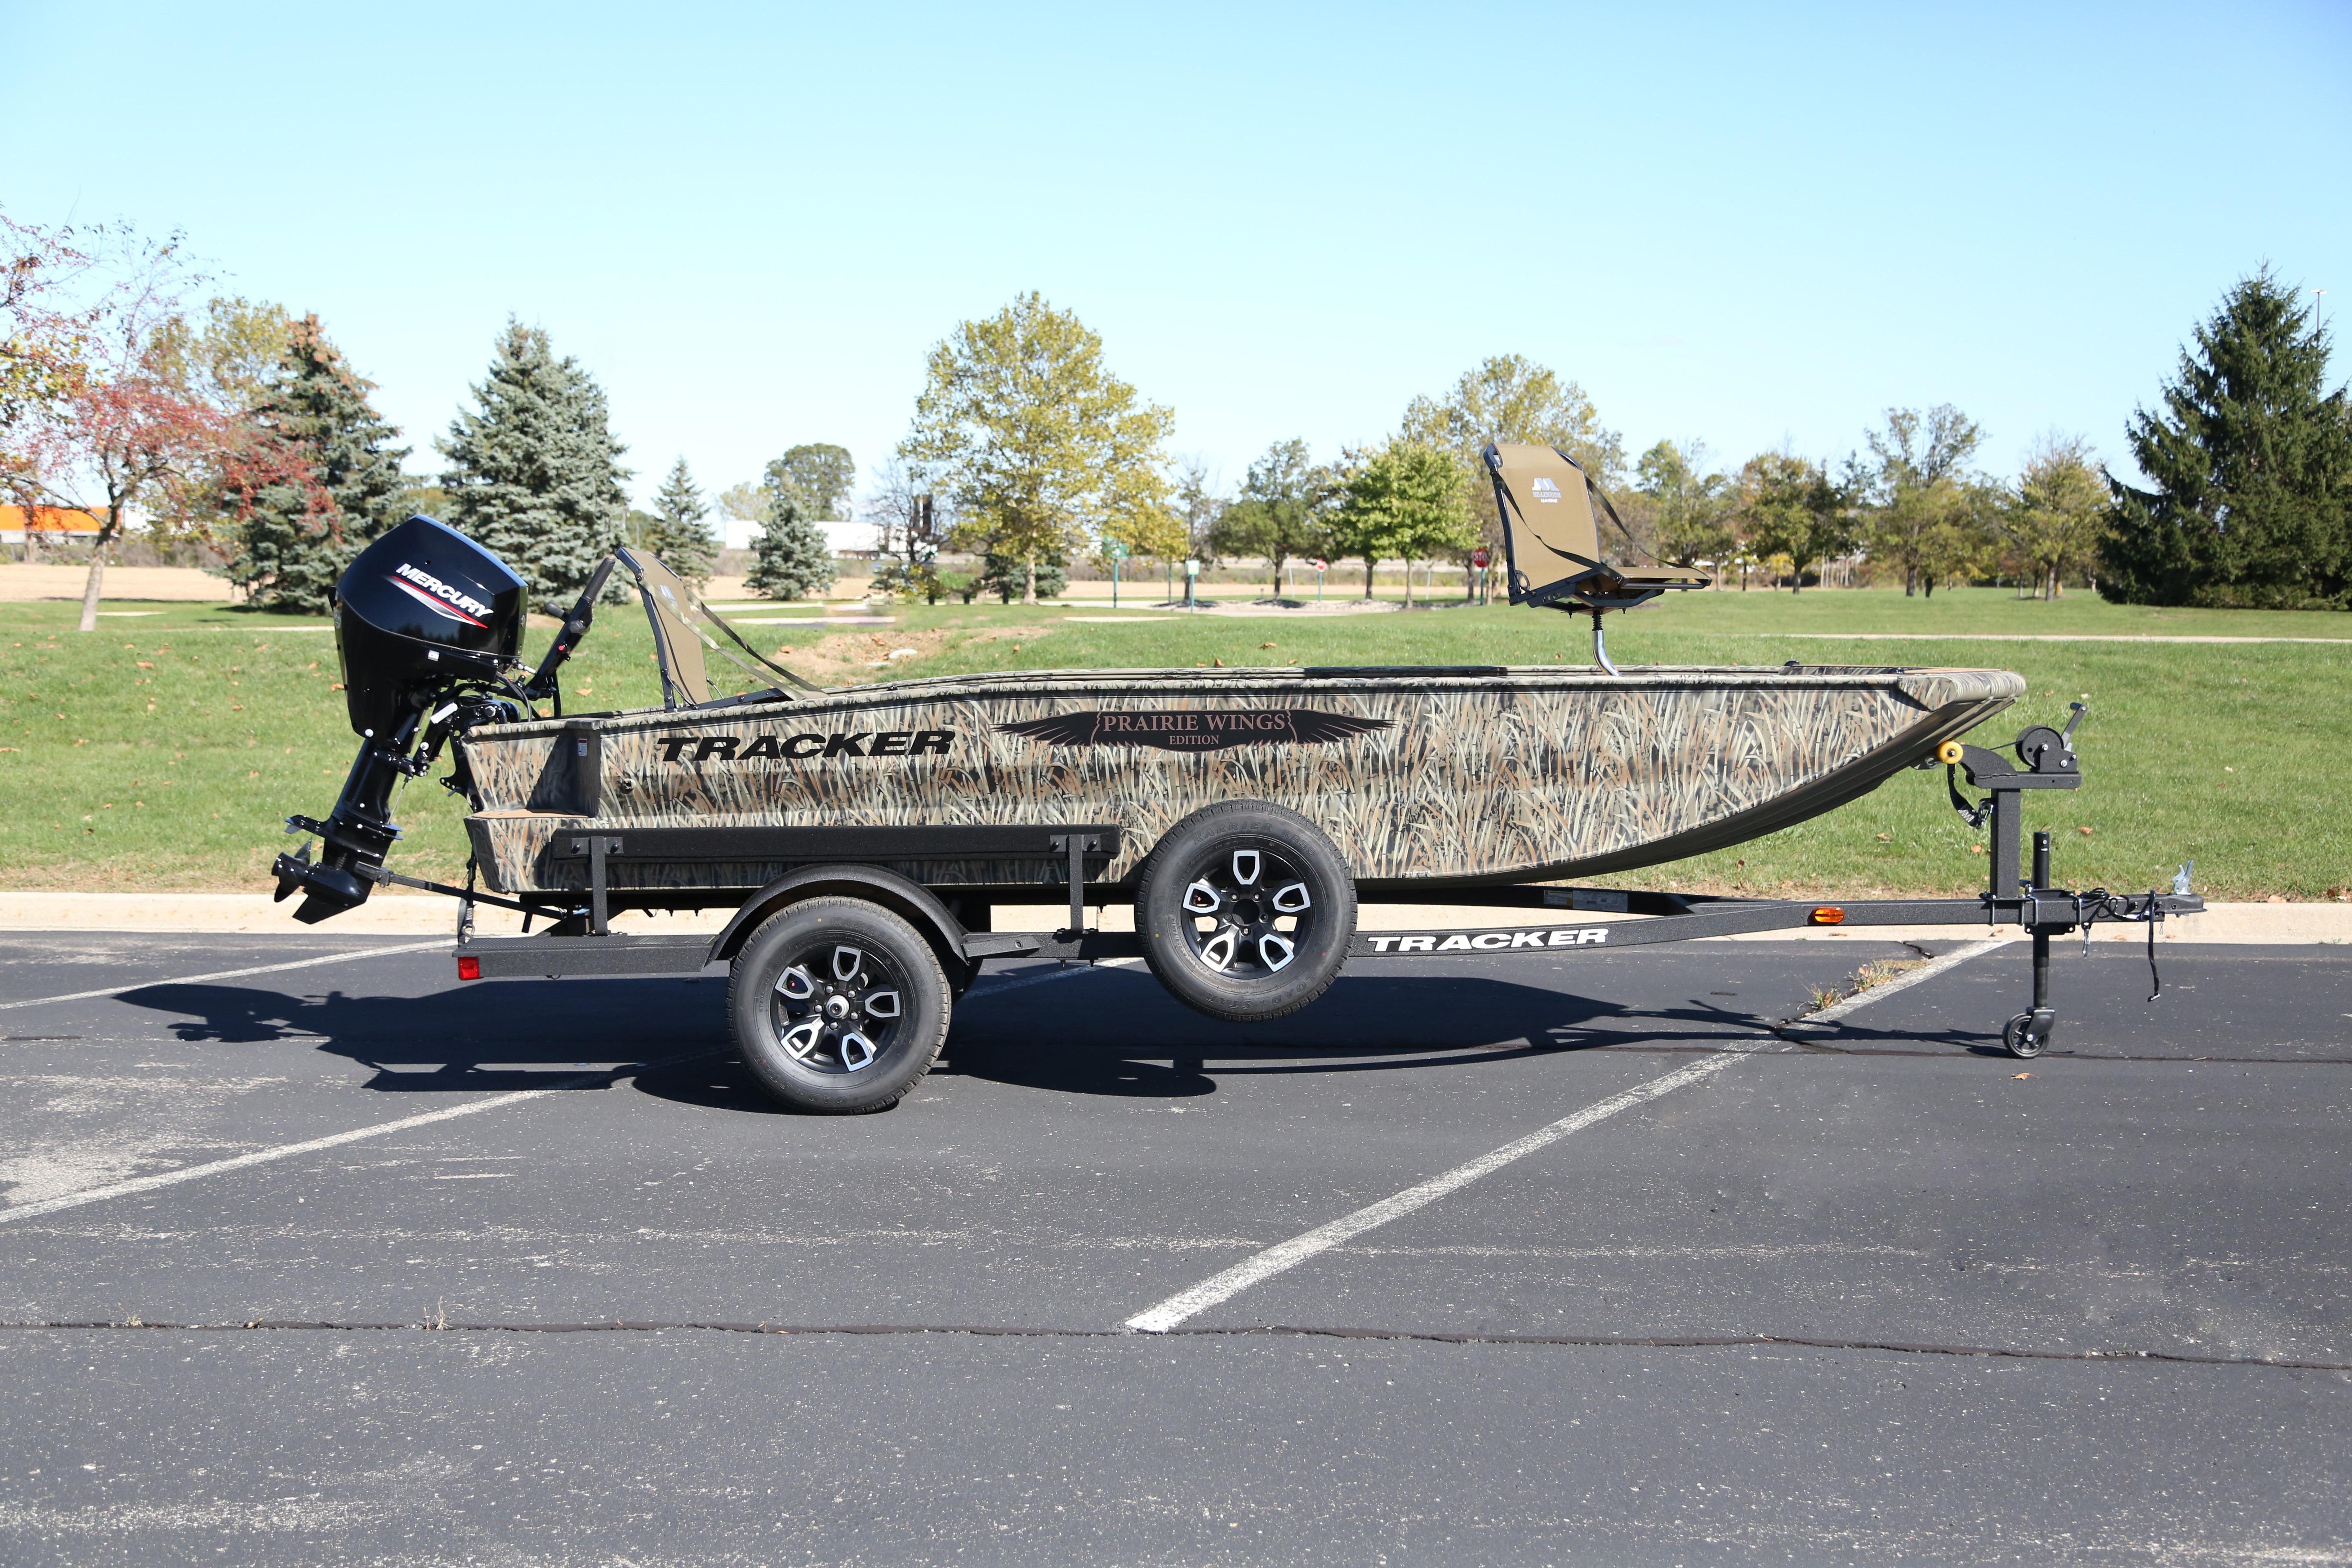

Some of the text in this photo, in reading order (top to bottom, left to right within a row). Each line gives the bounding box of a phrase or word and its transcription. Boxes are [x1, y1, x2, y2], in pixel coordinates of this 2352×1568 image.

[395, 563, 494, 617] MERCURY
[1103, 713, 1286, 731] PRAIRIE WINGS
[657, 731, 956, 762] TRACKER
[1169, 734, 1220, 745] EDITION
[1193, 821, 1273, 844] KARRIER
[1368, 928, 1609, 952] TRACKER
